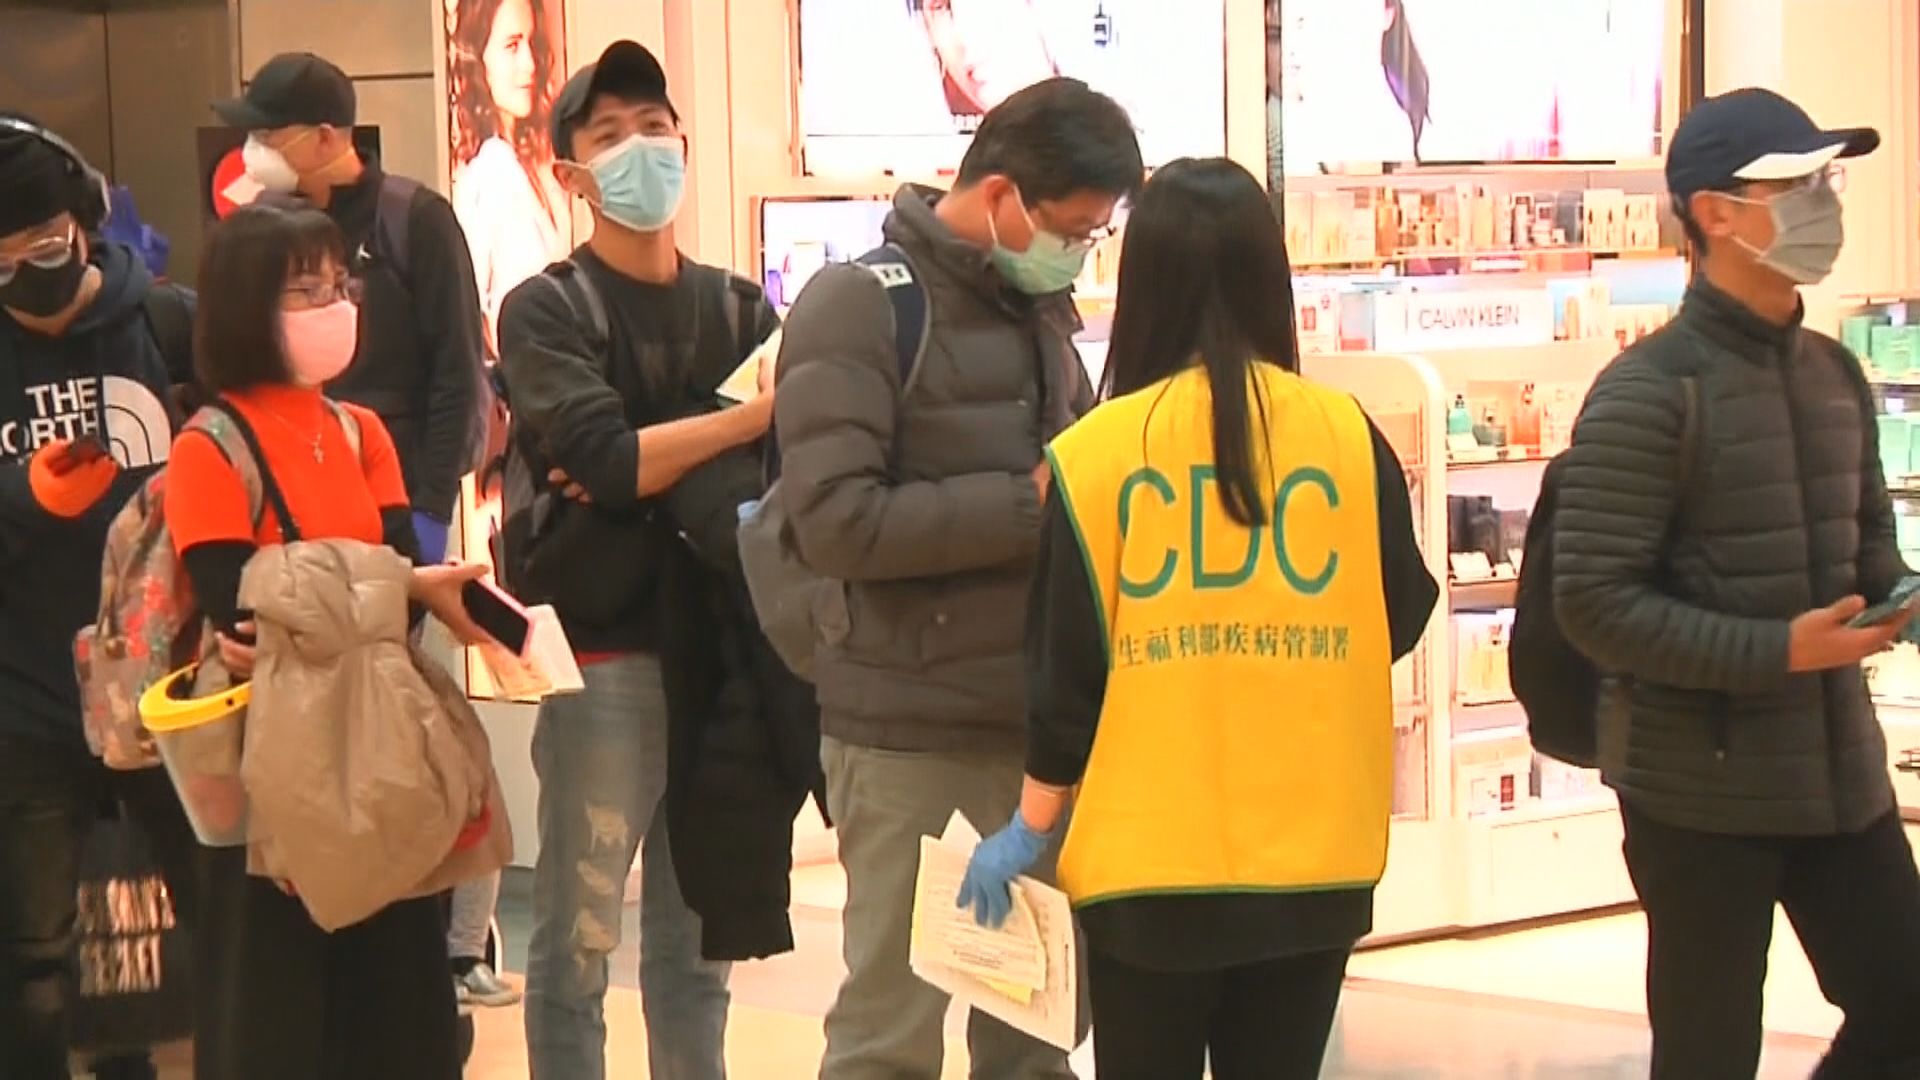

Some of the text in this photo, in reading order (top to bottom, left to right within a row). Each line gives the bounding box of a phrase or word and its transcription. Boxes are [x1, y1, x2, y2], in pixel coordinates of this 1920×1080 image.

[1419, 304, 1519, 330] CALVIN KLEIN
[25, 377, 97, 417] THE
[0, 410, 98, 455] ORTH
[1117, 464, 1339, 599] CDC
